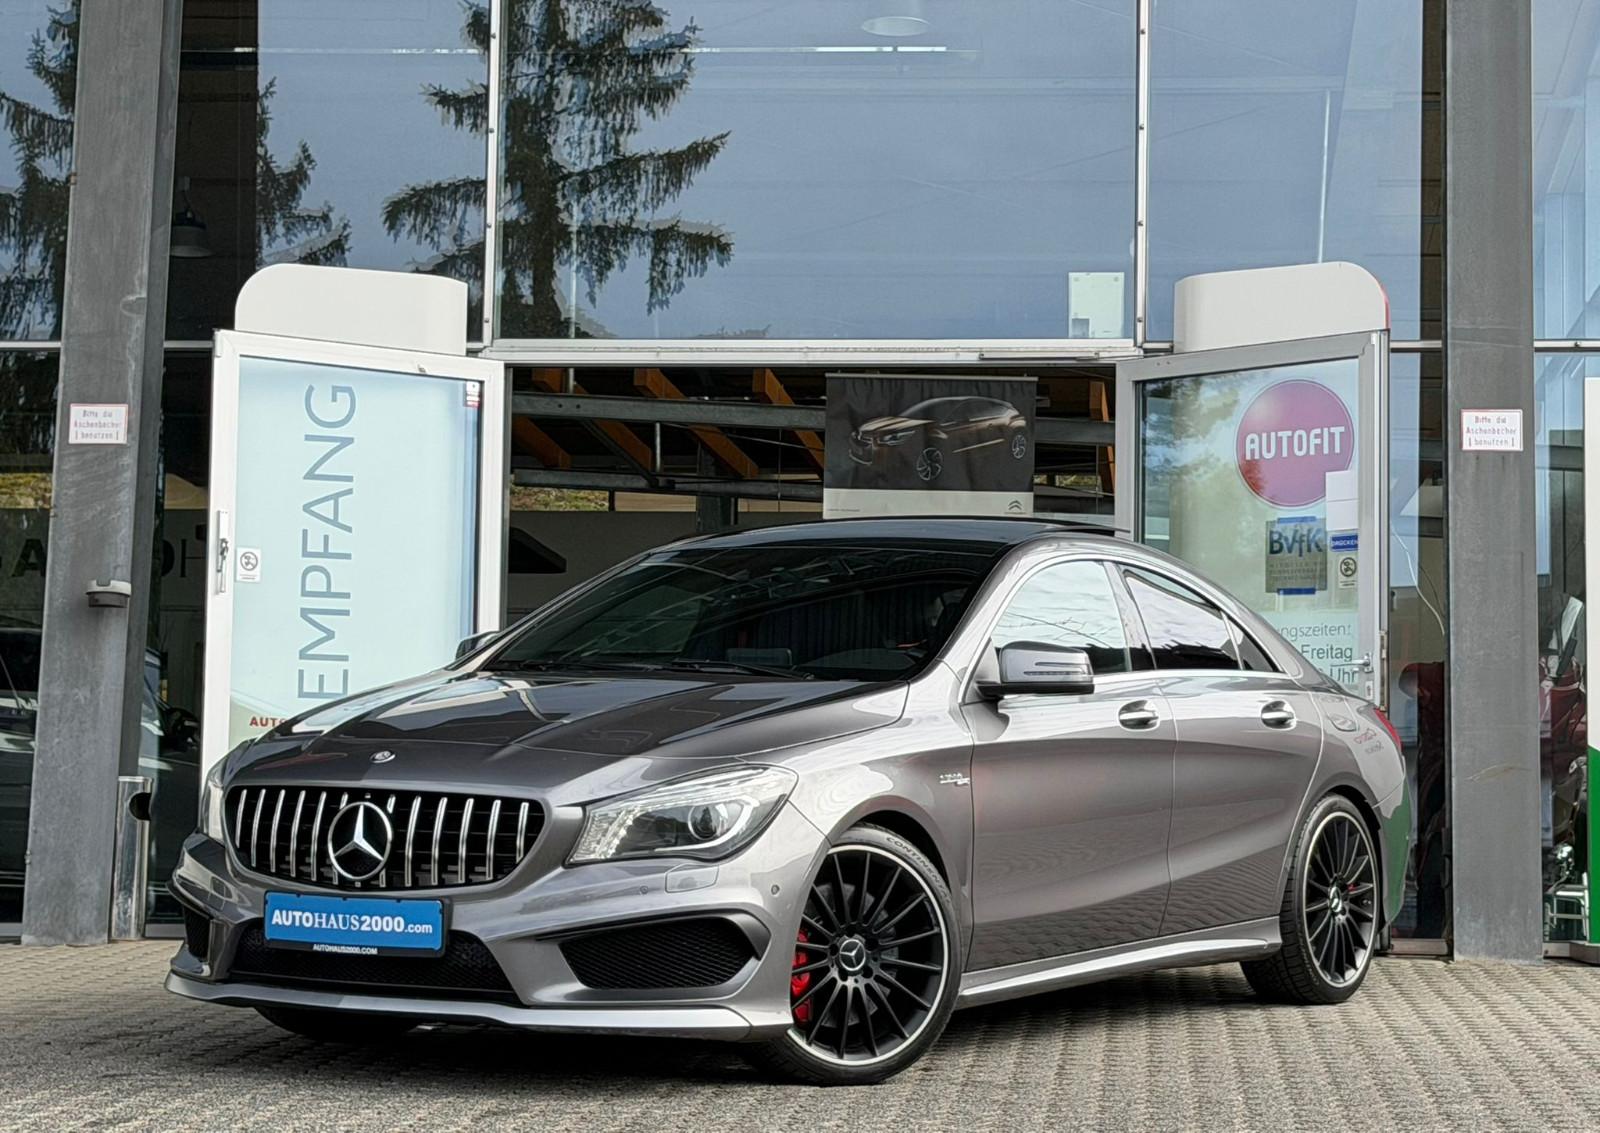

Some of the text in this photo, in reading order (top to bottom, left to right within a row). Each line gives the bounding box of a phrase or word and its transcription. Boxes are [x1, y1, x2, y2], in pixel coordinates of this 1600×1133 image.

[1245, 426, 1345, 460] AUTOFIT
[297, 384, 356, 698] EMPFANG
[1278, 622, 1352, 641] ngszeiten:
[1301, 643, 1353, 662] Freitag
[271, 908, 433, 935] AUTOHAUS2000.com
